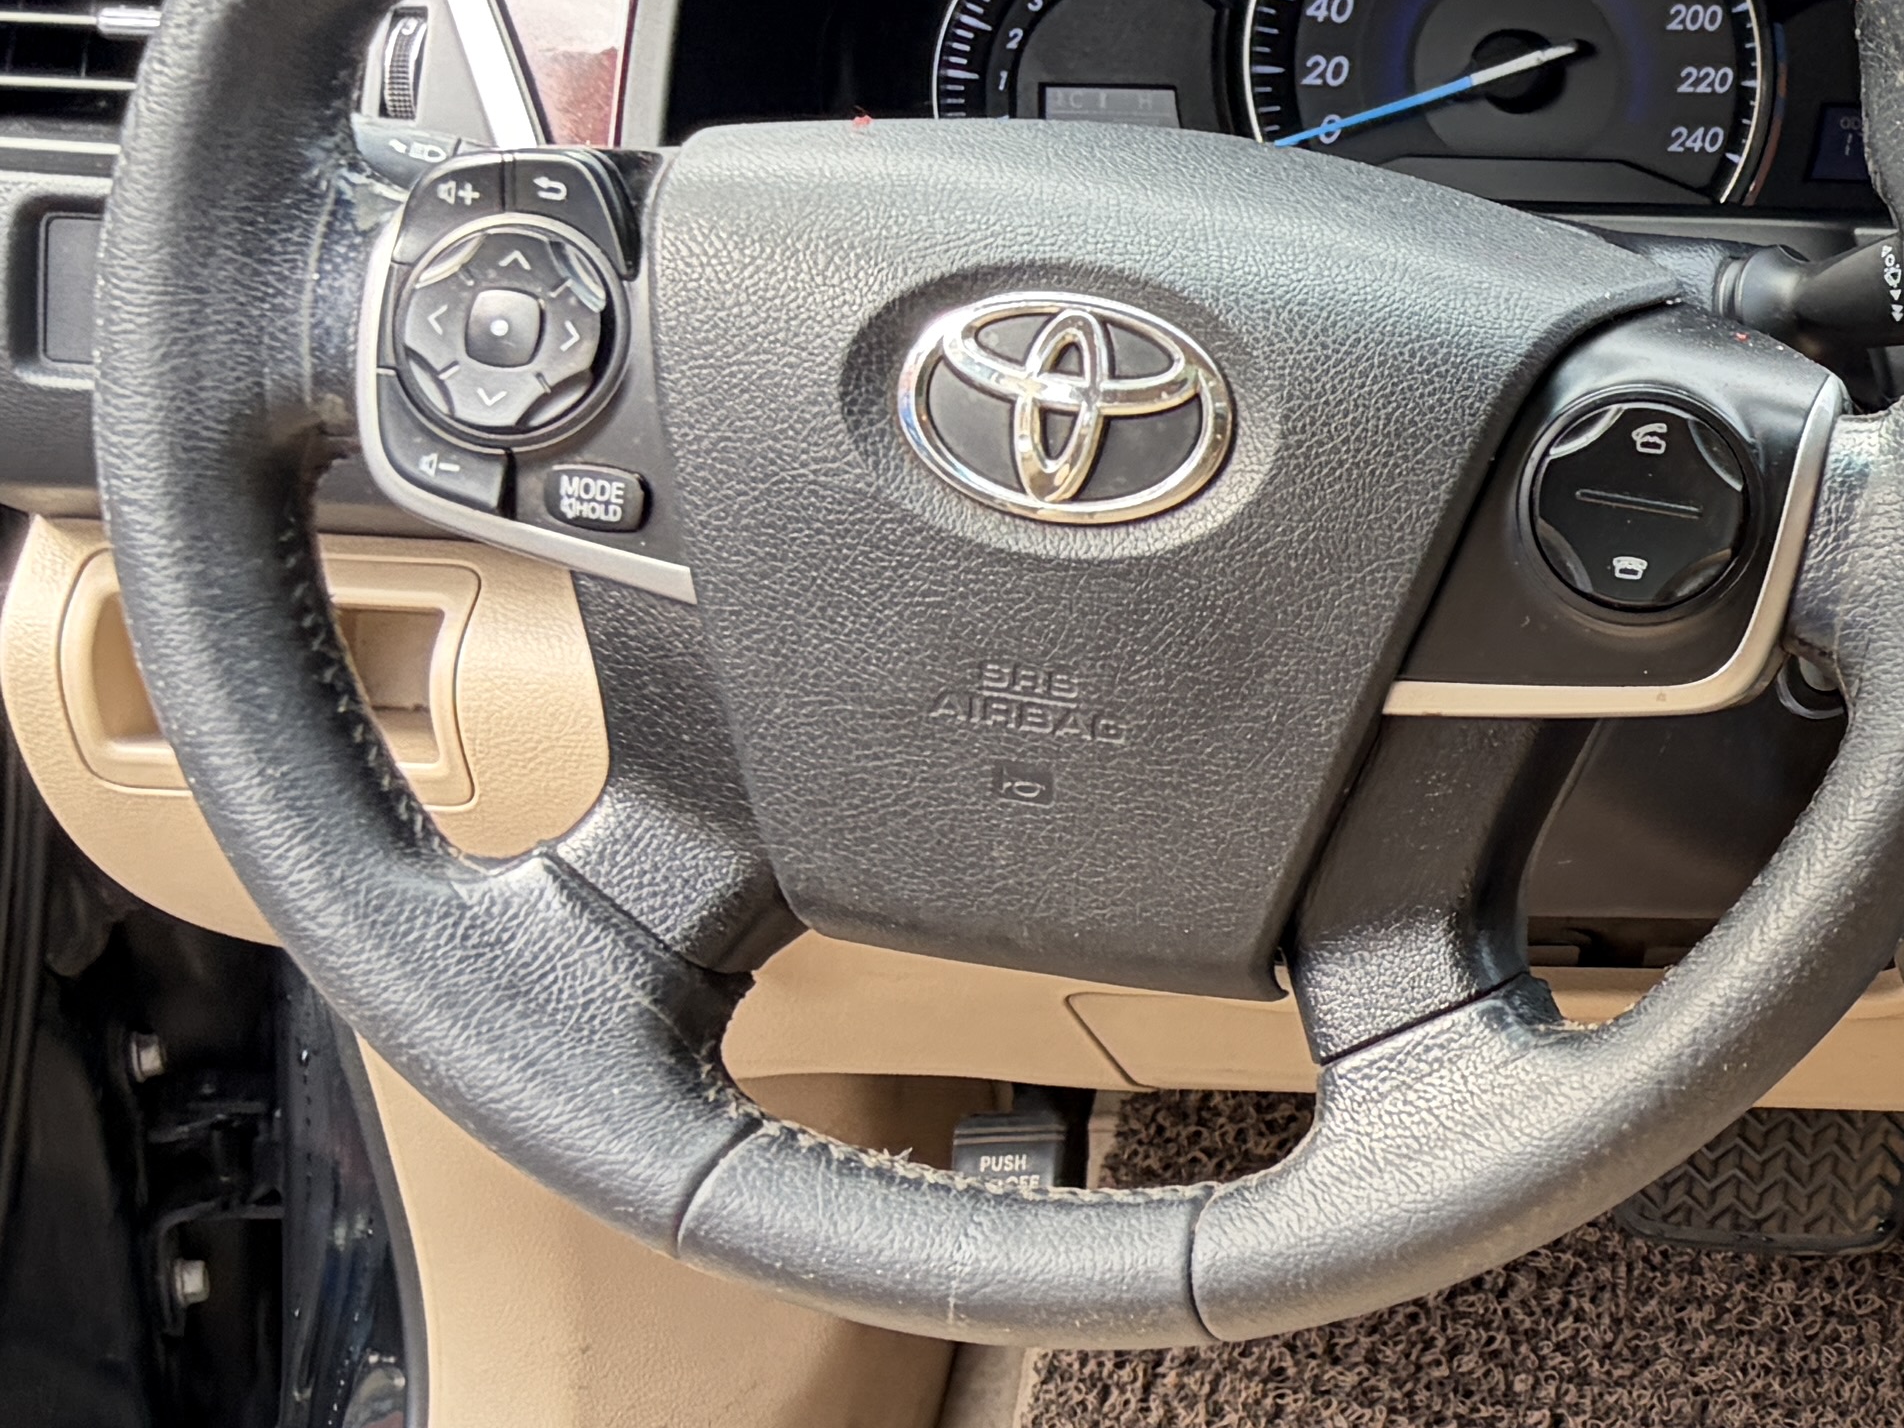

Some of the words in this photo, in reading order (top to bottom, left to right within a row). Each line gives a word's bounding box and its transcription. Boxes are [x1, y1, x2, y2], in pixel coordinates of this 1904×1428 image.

[1664, 3, 1724, 32] 200
[1006, 28, 1024, 49] 2
[998, 71, 1008, 91] 1
[1300, 54, 1350, 87] 20
[1676, 66, 1734, 94] 220
[1666, 126, 1725, 154] 240
[559, 474, 626, 505] MODE
[979, 1153, 1028, 1173] PUSH
